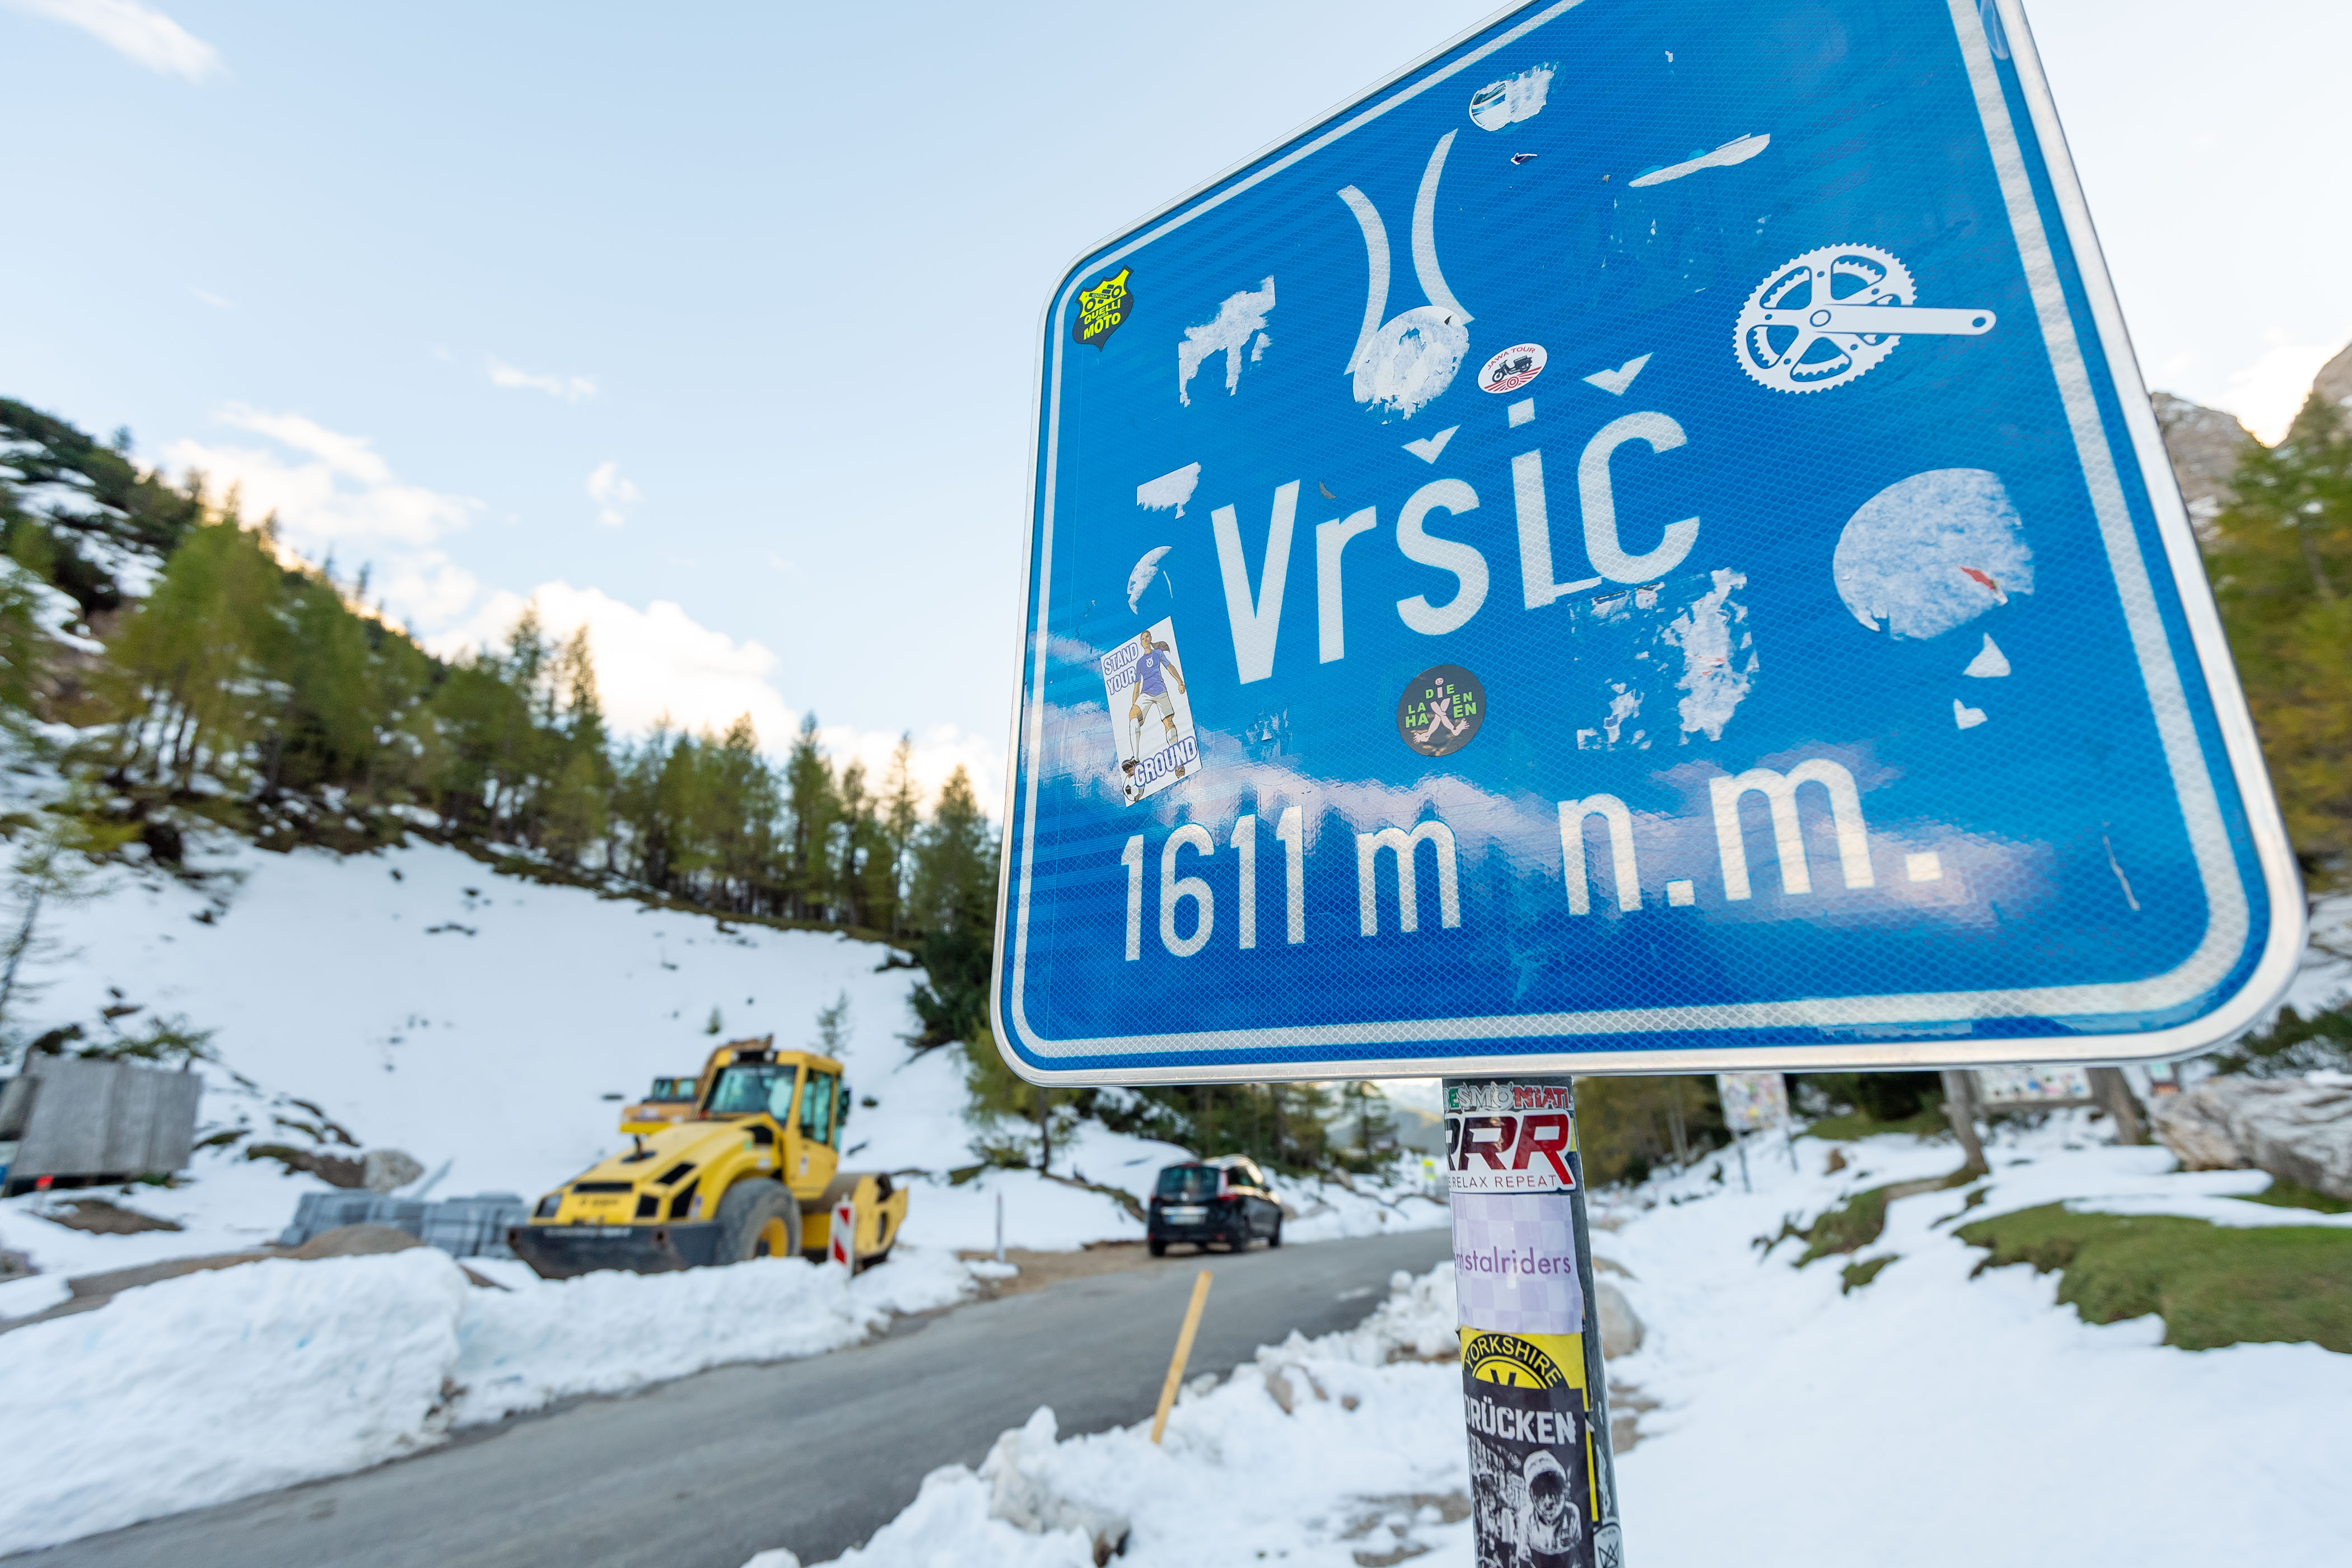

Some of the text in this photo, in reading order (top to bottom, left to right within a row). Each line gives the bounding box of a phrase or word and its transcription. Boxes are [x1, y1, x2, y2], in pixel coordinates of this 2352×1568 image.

[1084, 298, 1121, 325] QUELLI
[1084, 312, 1121, 340] MOTO
[1096, 312, 1109, 320] della
[1487, 351, 1509, 371] JAWA
[1211, 354, 1700, 684] Vršič
[1103, 642, 1139, 675] STAND
[1107, 666, 1137, 696] YOUR
[1133, 735, 1198, 788] GROUND
[1121, 805, 1305, 961] 1611
[1357, 820, 1461, 937] m
[1452, 1176, 1488, 1188] RELAX
[1494, 1174, 1556, 1188] REPEAT
[1465, 1336, 1562, 1388] YORKSHIRE
[1464, 1393, 1576, 1445] DRÜCKEN
